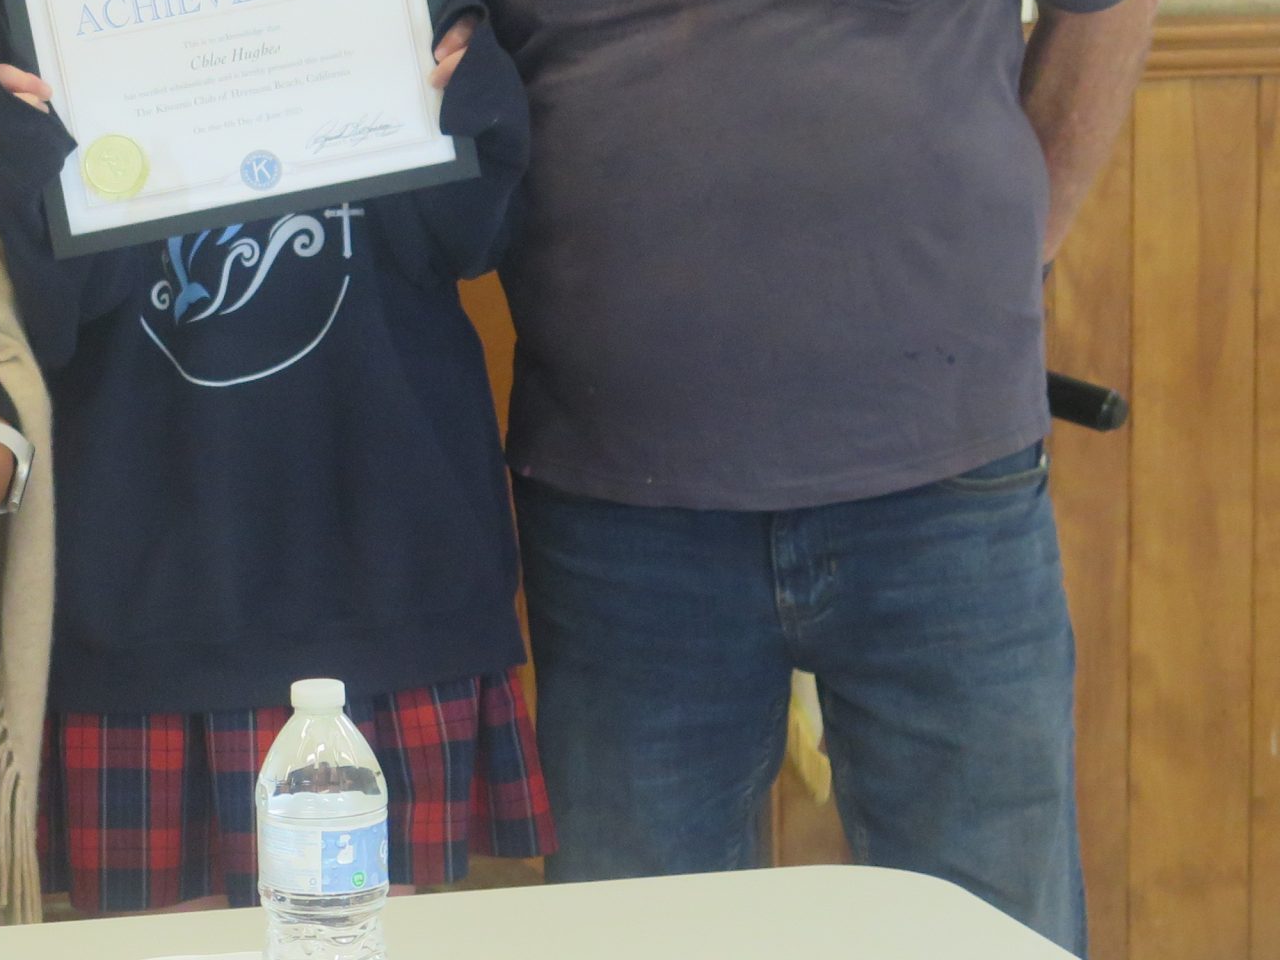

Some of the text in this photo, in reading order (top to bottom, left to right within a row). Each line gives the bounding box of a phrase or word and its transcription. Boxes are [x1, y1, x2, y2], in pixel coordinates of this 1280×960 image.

[190, 41, 281, 71] Chloe Hughes
[252, 159, 271, 184] K
